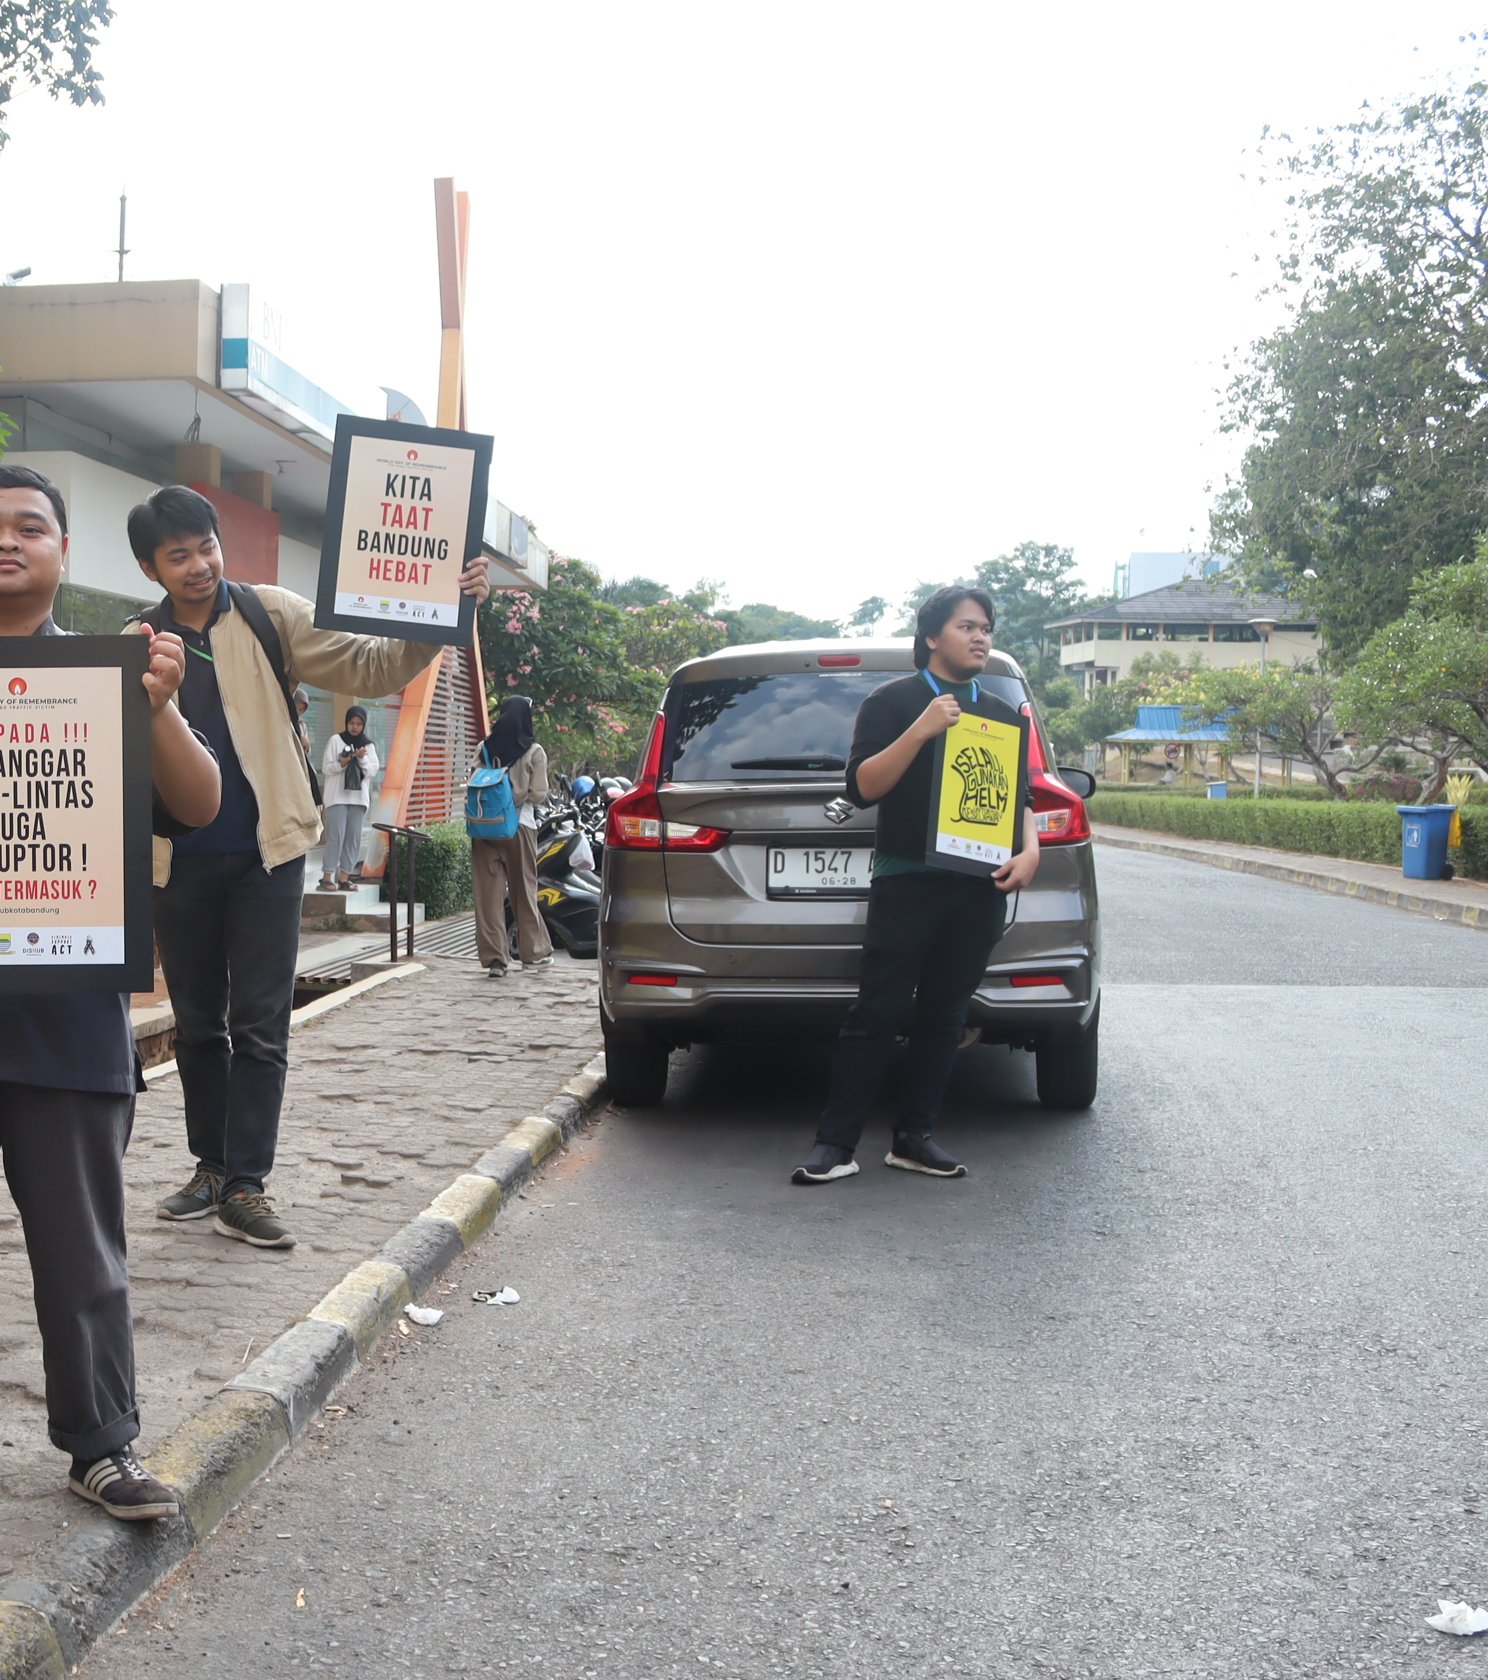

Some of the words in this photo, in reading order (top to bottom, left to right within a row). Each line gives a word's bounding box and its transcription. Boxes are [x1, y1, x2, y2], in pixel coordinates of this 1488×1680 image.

[385, 473, 433, 502] KITA
[380, 502, 433, 531] TAAT
[356, 529, 449, 561] BANDUNG
[368, 557, 432, 586] HEBAT
[63, 722, 89, 743] !!!
[955, 746, 1004, 774] SELALU
[966, 768, 1009, 793] GUNAKAN
[964, 787, 1009, 813] HELM
[82, 843, 87, 872] !
[773, 850, 785, 874] D
[803, 850, 853, 874] 1547
[88, 879, 97, 900] ?
[51, 944, 72, 956] ACT
